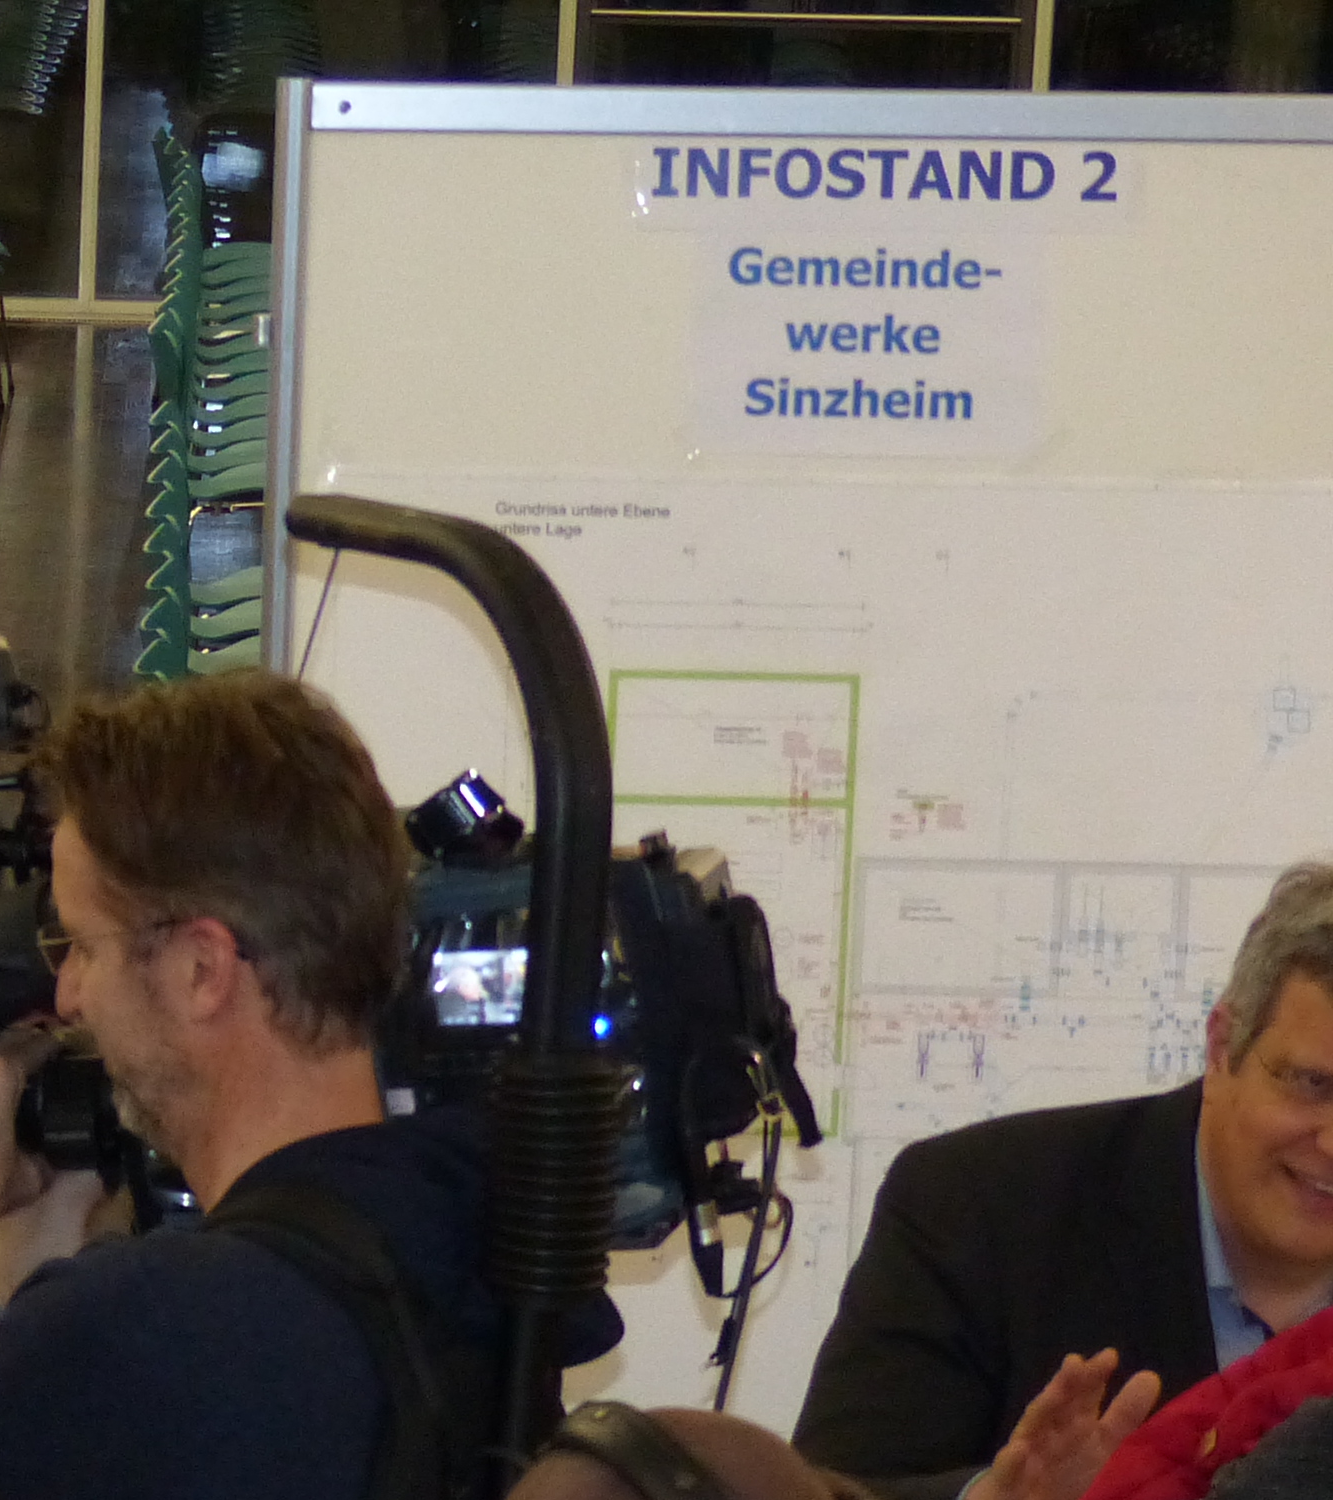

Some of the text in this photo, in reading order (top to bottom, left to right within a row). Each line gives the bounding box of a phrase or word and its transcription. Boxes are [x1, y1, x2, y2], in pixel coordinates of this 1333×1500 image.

[651, 146, 1118, 203] INFOSTAND 2
[728, 245, 1003, 291] Gemeinde-
[784, 314, 941, 356] werke
[742, 378, 974, 421] Sinzheim
